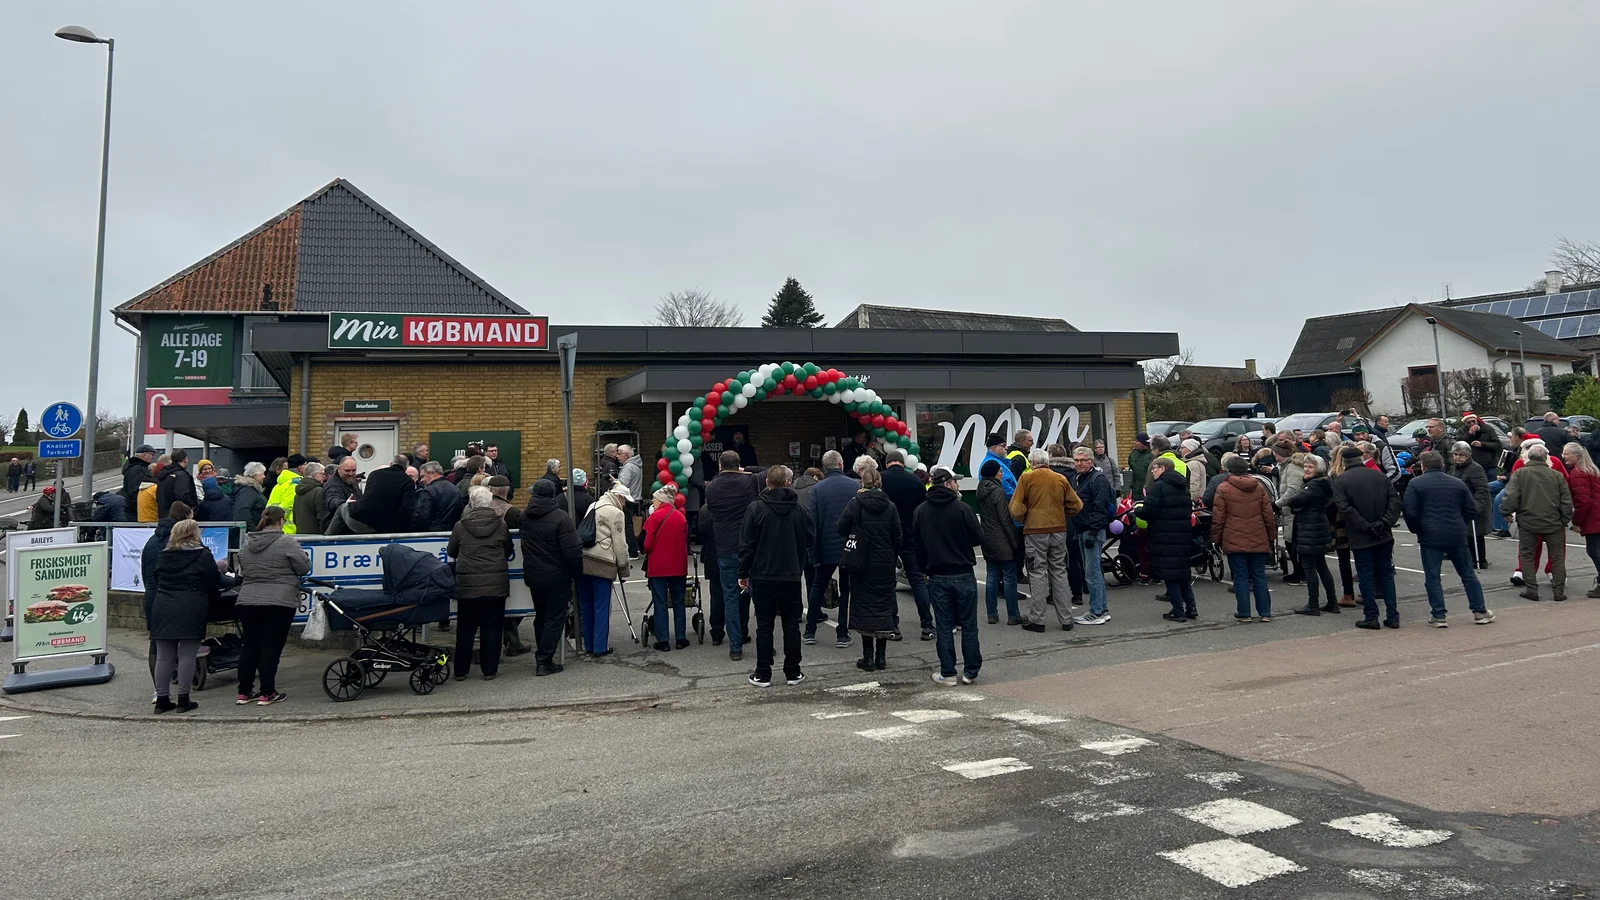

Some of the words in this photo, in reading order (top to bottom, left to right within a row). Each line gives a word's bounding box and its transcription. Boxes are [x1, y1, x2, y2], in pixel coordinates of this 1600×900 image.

[333, 318, 398, 342] Min
[409, 320, 540, 343] KØBMAND
[161, 333, 189, 347] ALLE
[191, 333, 222, 347] DAGE
[174, 349, 208, 368] 7-19
[31, 536, 54, 544] BAILEYS
[30, 554, 92, 570] FRISKSMURT
[35, 566, 87, 581] SANDWICH
